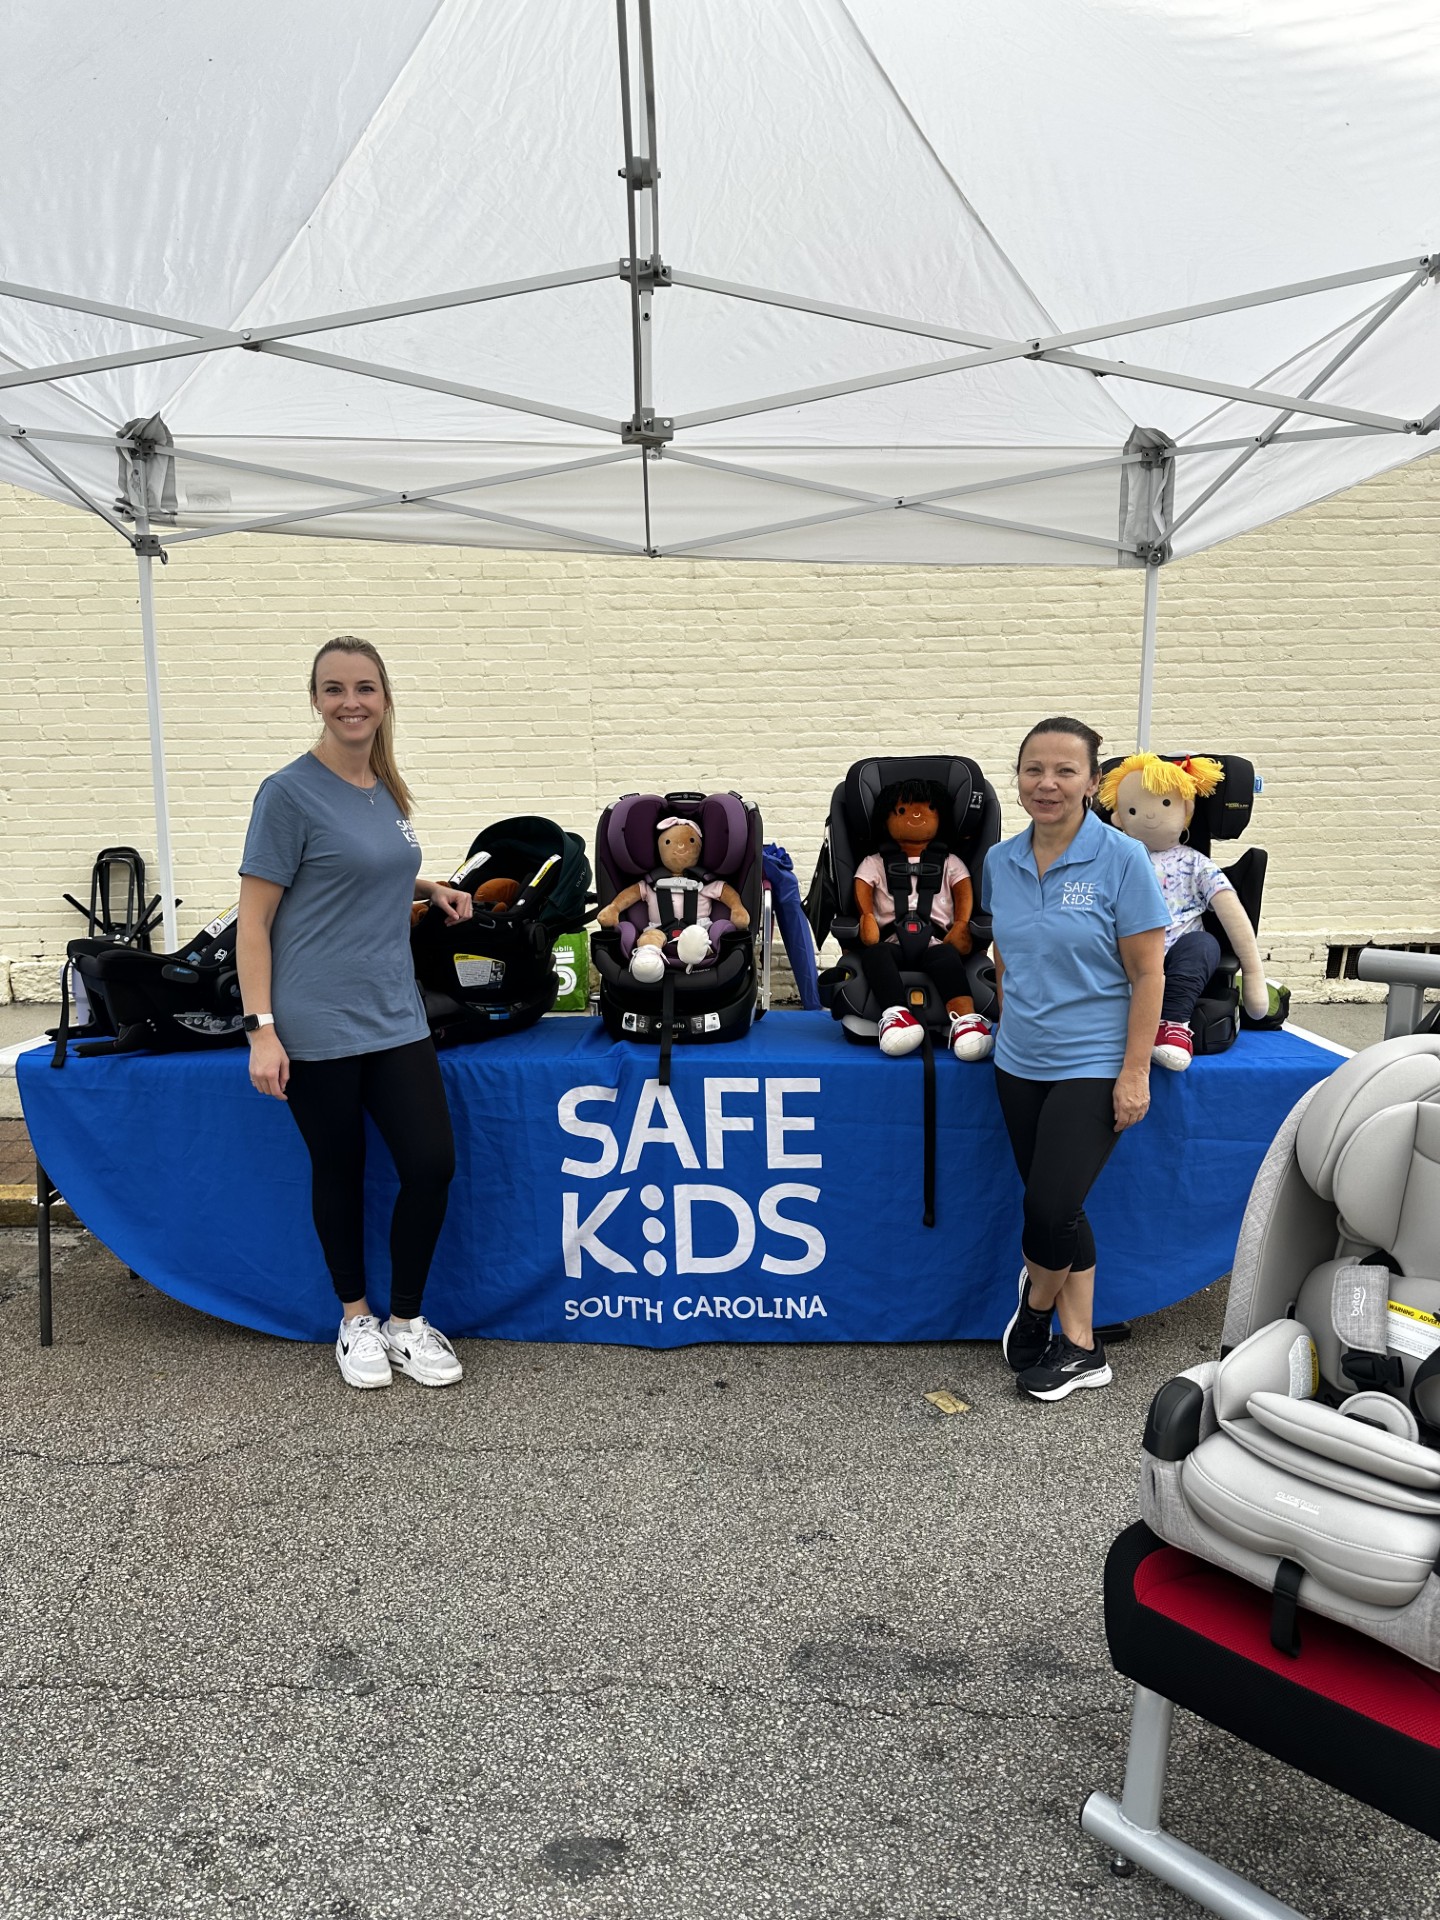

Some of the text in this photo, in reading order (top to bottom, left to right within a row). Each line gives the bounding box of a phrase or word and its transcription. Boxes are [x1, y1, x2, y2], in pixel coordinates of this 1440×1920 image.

[1063, 881, 1096, 894] SAFE
[557, 1077, 823, 1179] SAFE
[564, 1295, 828, 1324] SOUTH CAROLINA
[1350, 1286, 1362, 1317] britax
[1389, 1303, 1415, 1317] WARNING
